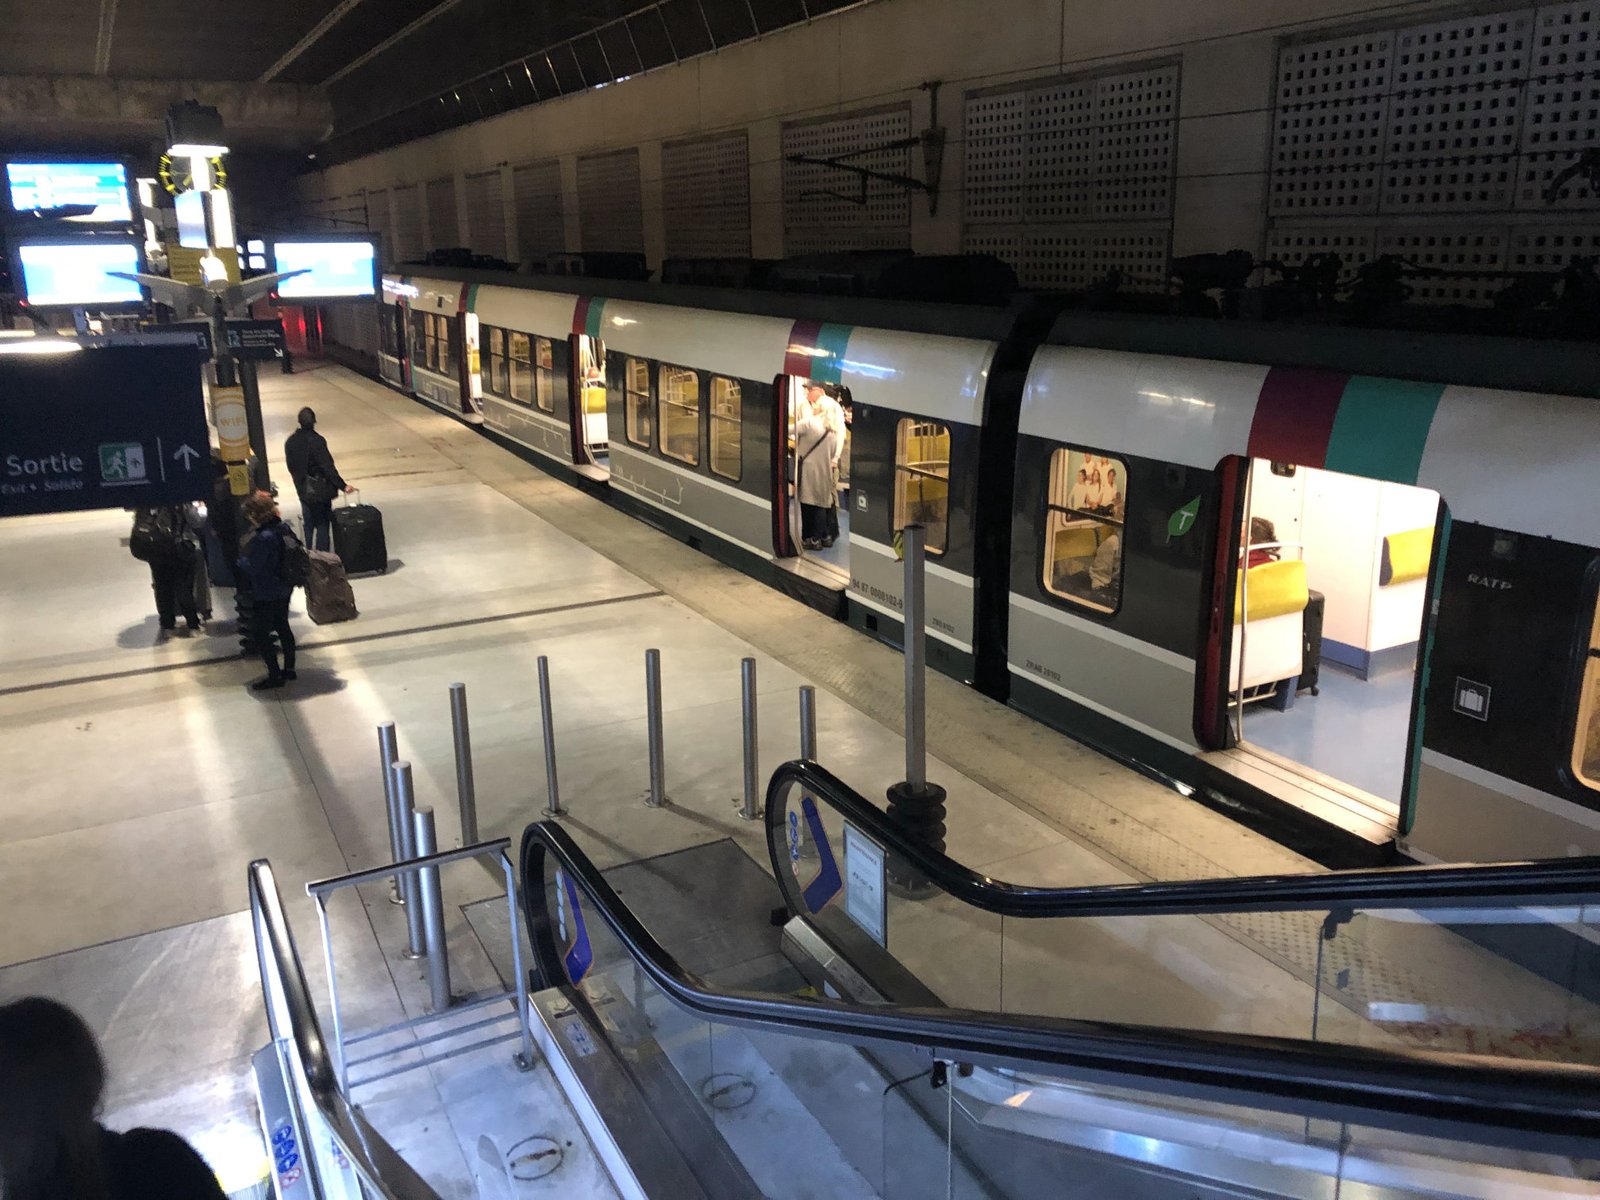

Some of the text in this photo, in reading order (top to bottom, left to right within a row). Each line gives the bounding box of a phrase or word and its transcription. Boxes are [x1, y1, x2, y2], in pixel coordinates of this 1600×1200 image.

[6, 452, 84, 477] Sortie
[1180, 510, 1194, 530] T
[1467, 573, 1512, 590] RATP
